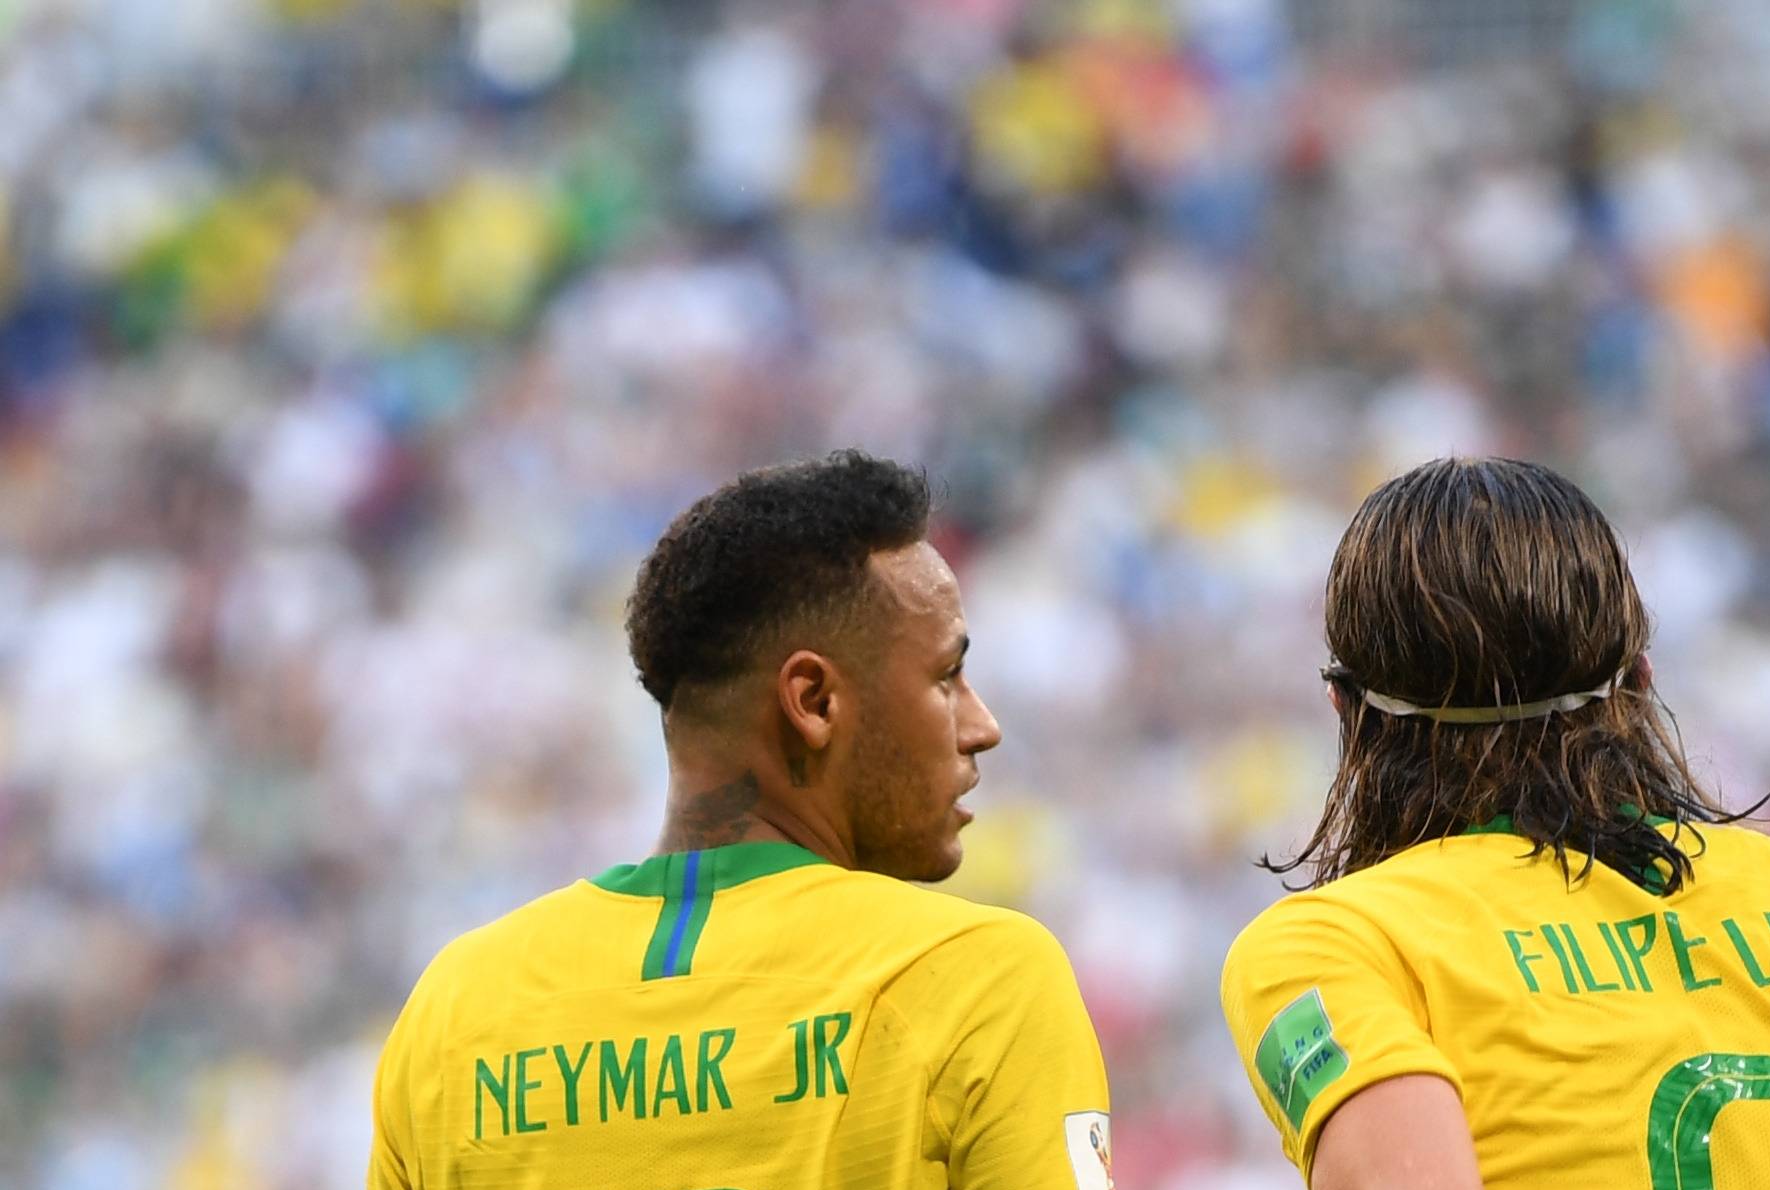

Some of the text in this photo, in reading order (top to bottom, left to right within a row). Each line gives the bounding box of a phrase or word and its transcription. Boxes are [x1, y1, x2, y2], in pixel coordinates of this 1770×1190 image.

[1503, 911, 1723, 994] FILIPE
[475, 1012, 852, 1140] NEYMAR JR
